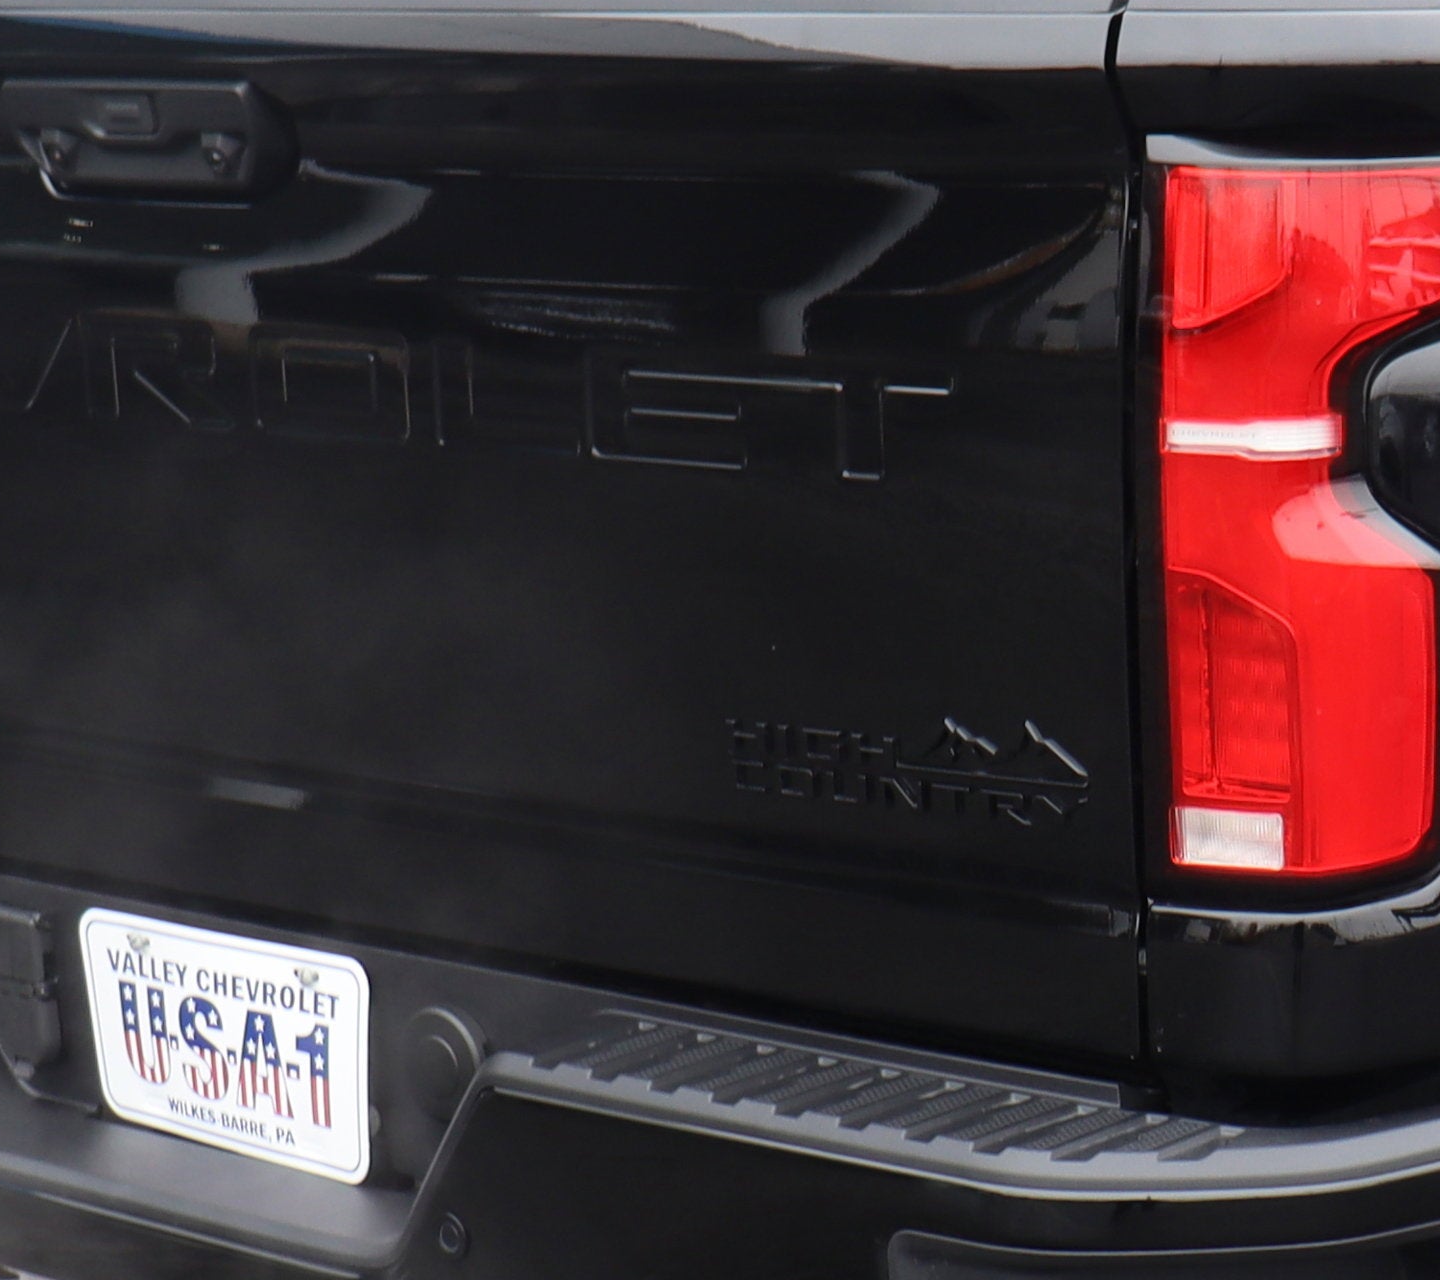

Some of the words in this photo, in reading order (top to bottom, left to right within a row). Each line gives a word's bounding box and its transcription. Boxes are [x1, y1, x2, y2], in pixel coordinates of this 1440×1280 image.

[106, 948, 188, 988] VALLEY
[196, 967, 340, 1021] CHEVROLET
[275, 1125, 296, 1147] PA
